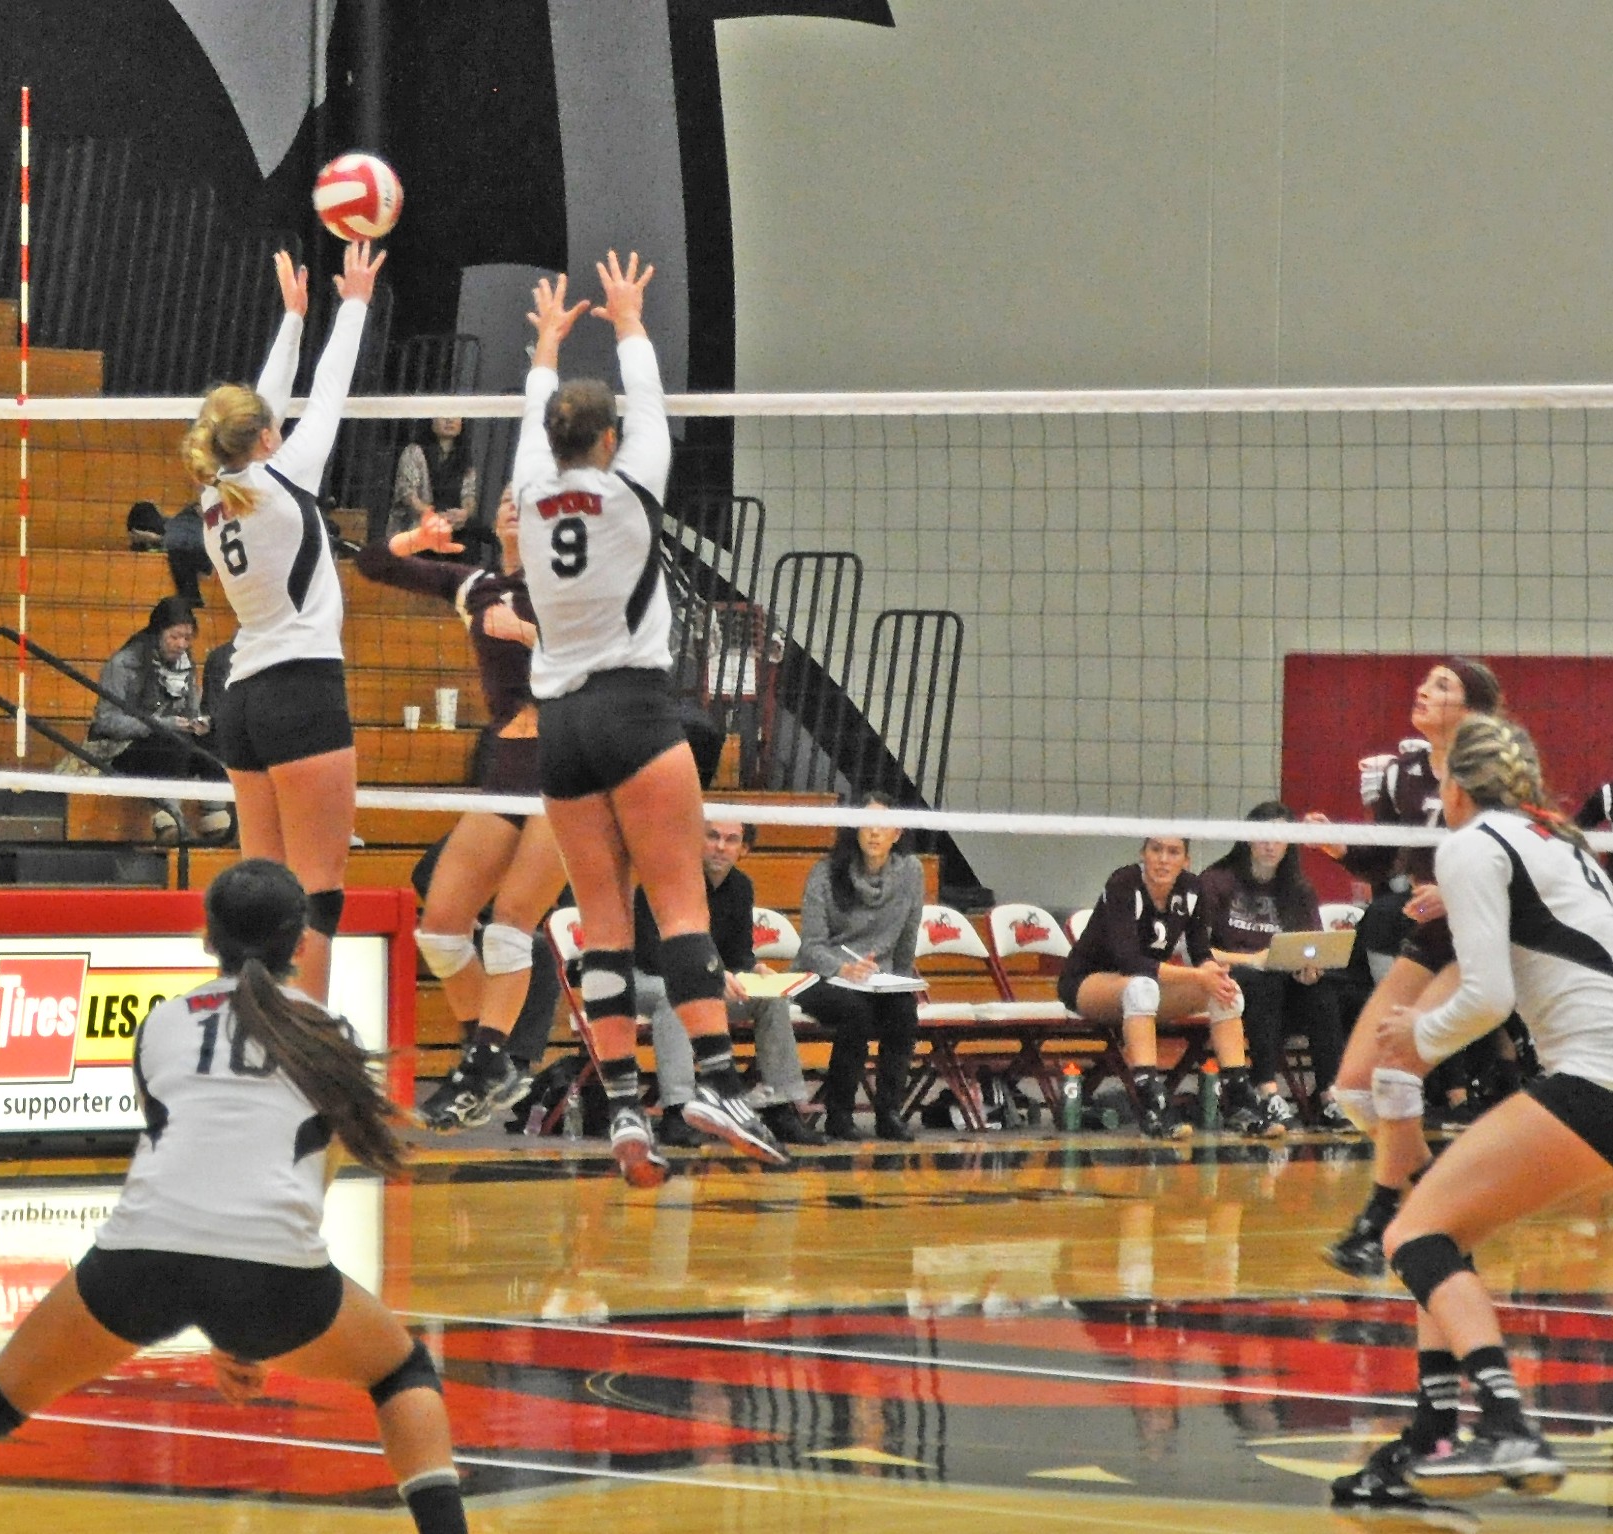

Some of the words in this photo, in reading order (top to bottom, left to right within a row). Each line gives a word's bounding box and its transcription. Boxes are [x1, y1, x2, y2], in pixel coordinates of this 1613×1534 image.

[219, 519, 248, 577] 6
[550, 517, 588, 579] 9
[85, 994, 139, 1038] LES
[3, 1092, 112, 1120] supporter
